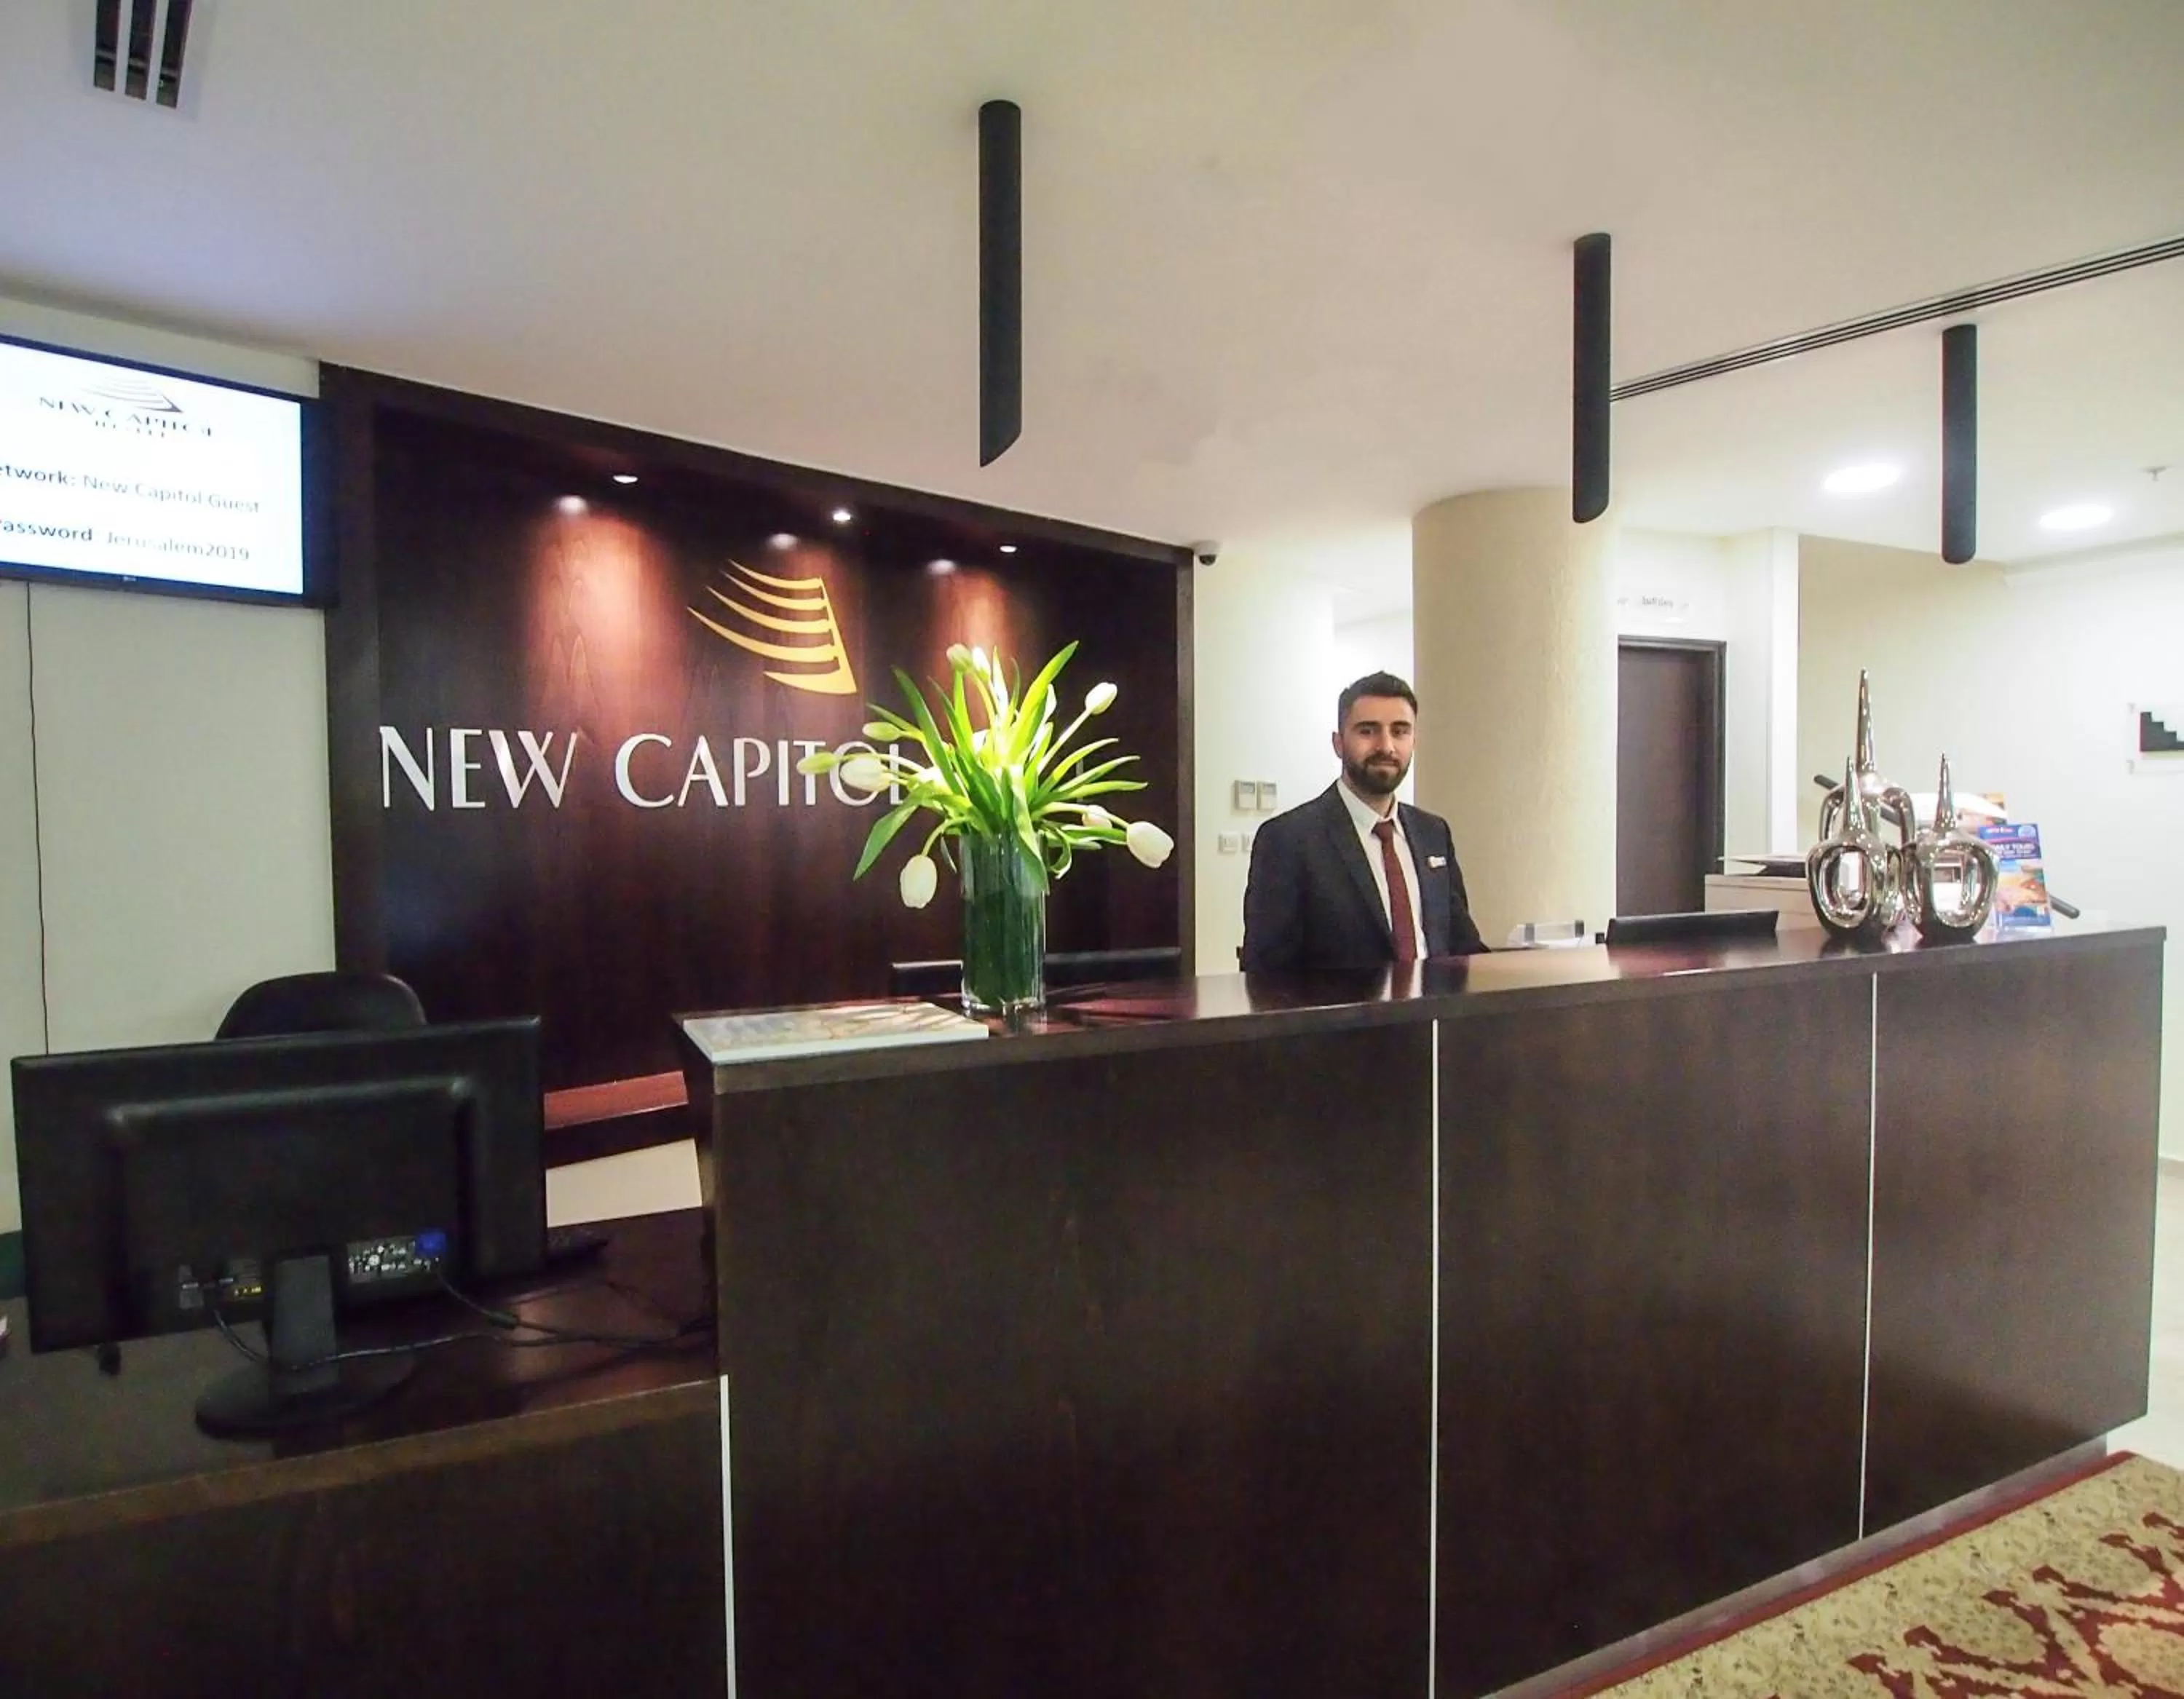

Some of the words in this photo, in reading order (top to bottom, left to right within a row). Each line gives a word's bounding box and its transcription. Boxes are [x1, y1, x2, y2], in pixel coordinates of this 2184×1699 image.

[0, 464, 76, 487] twork:
[83, 474, 129, 494] New
[135, 483, 202, 504] Capitol
[208, 493, 260, 513] Guest
[0, 519, 92, 542] assword
[108, 531, 250, 561] Jerusalem2019
[379, 726, 577, 811] NEW
